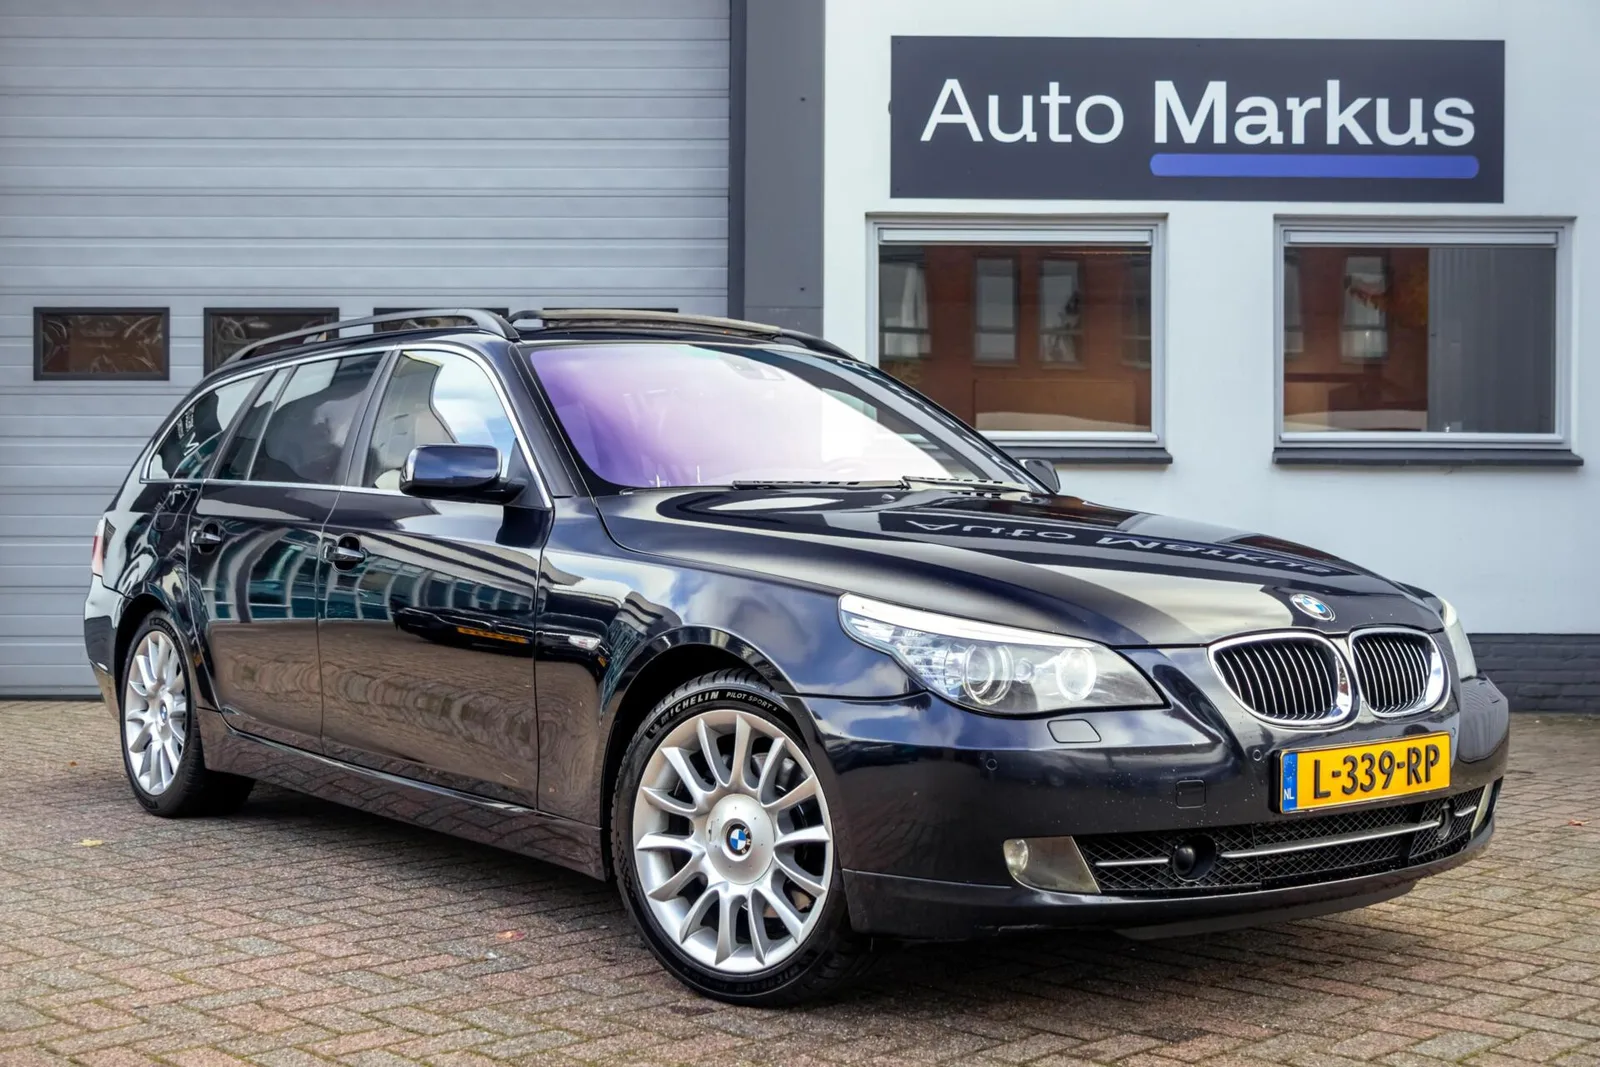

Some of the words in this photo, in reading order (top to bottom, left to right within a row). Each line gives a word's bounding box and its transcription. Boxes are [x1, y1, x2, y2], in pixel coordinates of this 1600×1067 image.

[920, 78, 1124, 144] Auto
[1154, 79, 1475, 147] Markus
[660, 691, 719, 725] MICHELIN
[726, 691, 747, 700] PILOT
[1284, 788, 1294, 800] NL
[1314, 744, 1440, 799] L-339-RP
